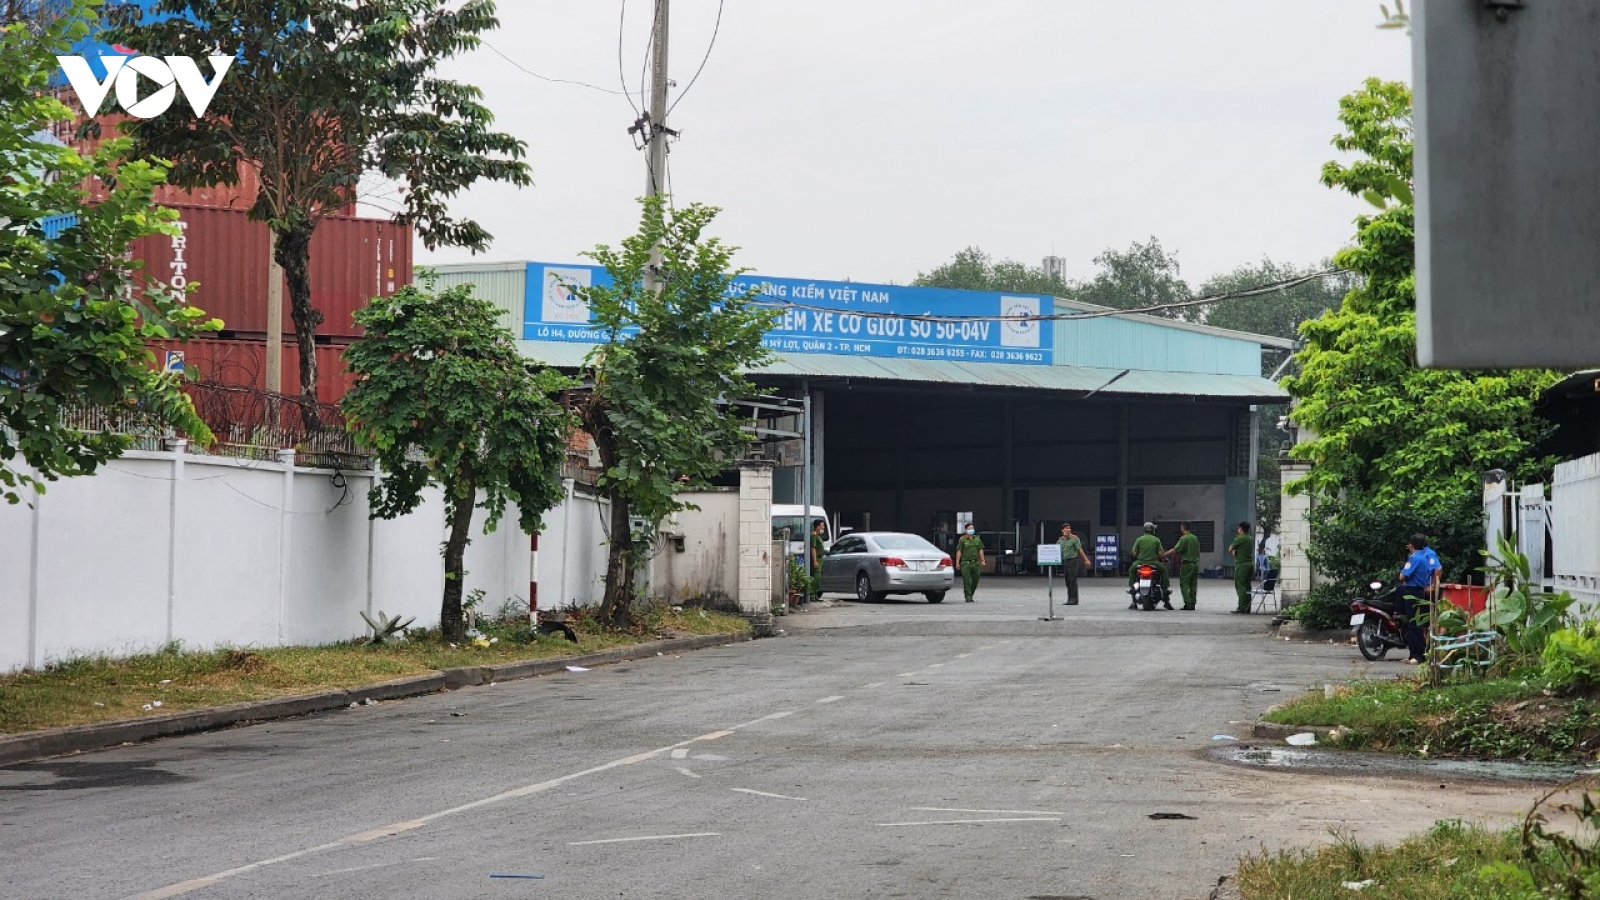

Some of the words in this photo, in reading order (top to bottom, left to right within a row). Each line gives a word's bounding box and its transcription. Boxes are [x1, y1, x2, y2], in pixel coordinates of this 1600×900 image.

[170, 221, 188, 302] TRITON
[724, 282, 746, 296] ỤC
[792, 284, 825, 299] KIỂM
[829, 287, 858, 304] VIỆT
[861, 291, 889, 303] NAM
[538, 327, 549, 337] LÔ
[551, 329, 565, 338] H4,
[568, 328, 600, 339] ĐƯỜNG
[812, 312, 833, 333] XE
[936, 321, 990, 341] 50-04V
[802, 340, 825, 351] QUẬN
[827, 343, 832, 351] 2
[839, 343, 851, 351] TP.
[853, 344, 871, 352] HCM
[911, 346, 925, 355] 028
[926, 346, 944, 356] 3636
[946, 348, 965, 357] 9255
[970, 349, 987, 359] FAX:
[990, 350, 1005, 359] 028
[1005, 351, 1024, 360] 3636
[1025, 352, 1043, 361] 9622
